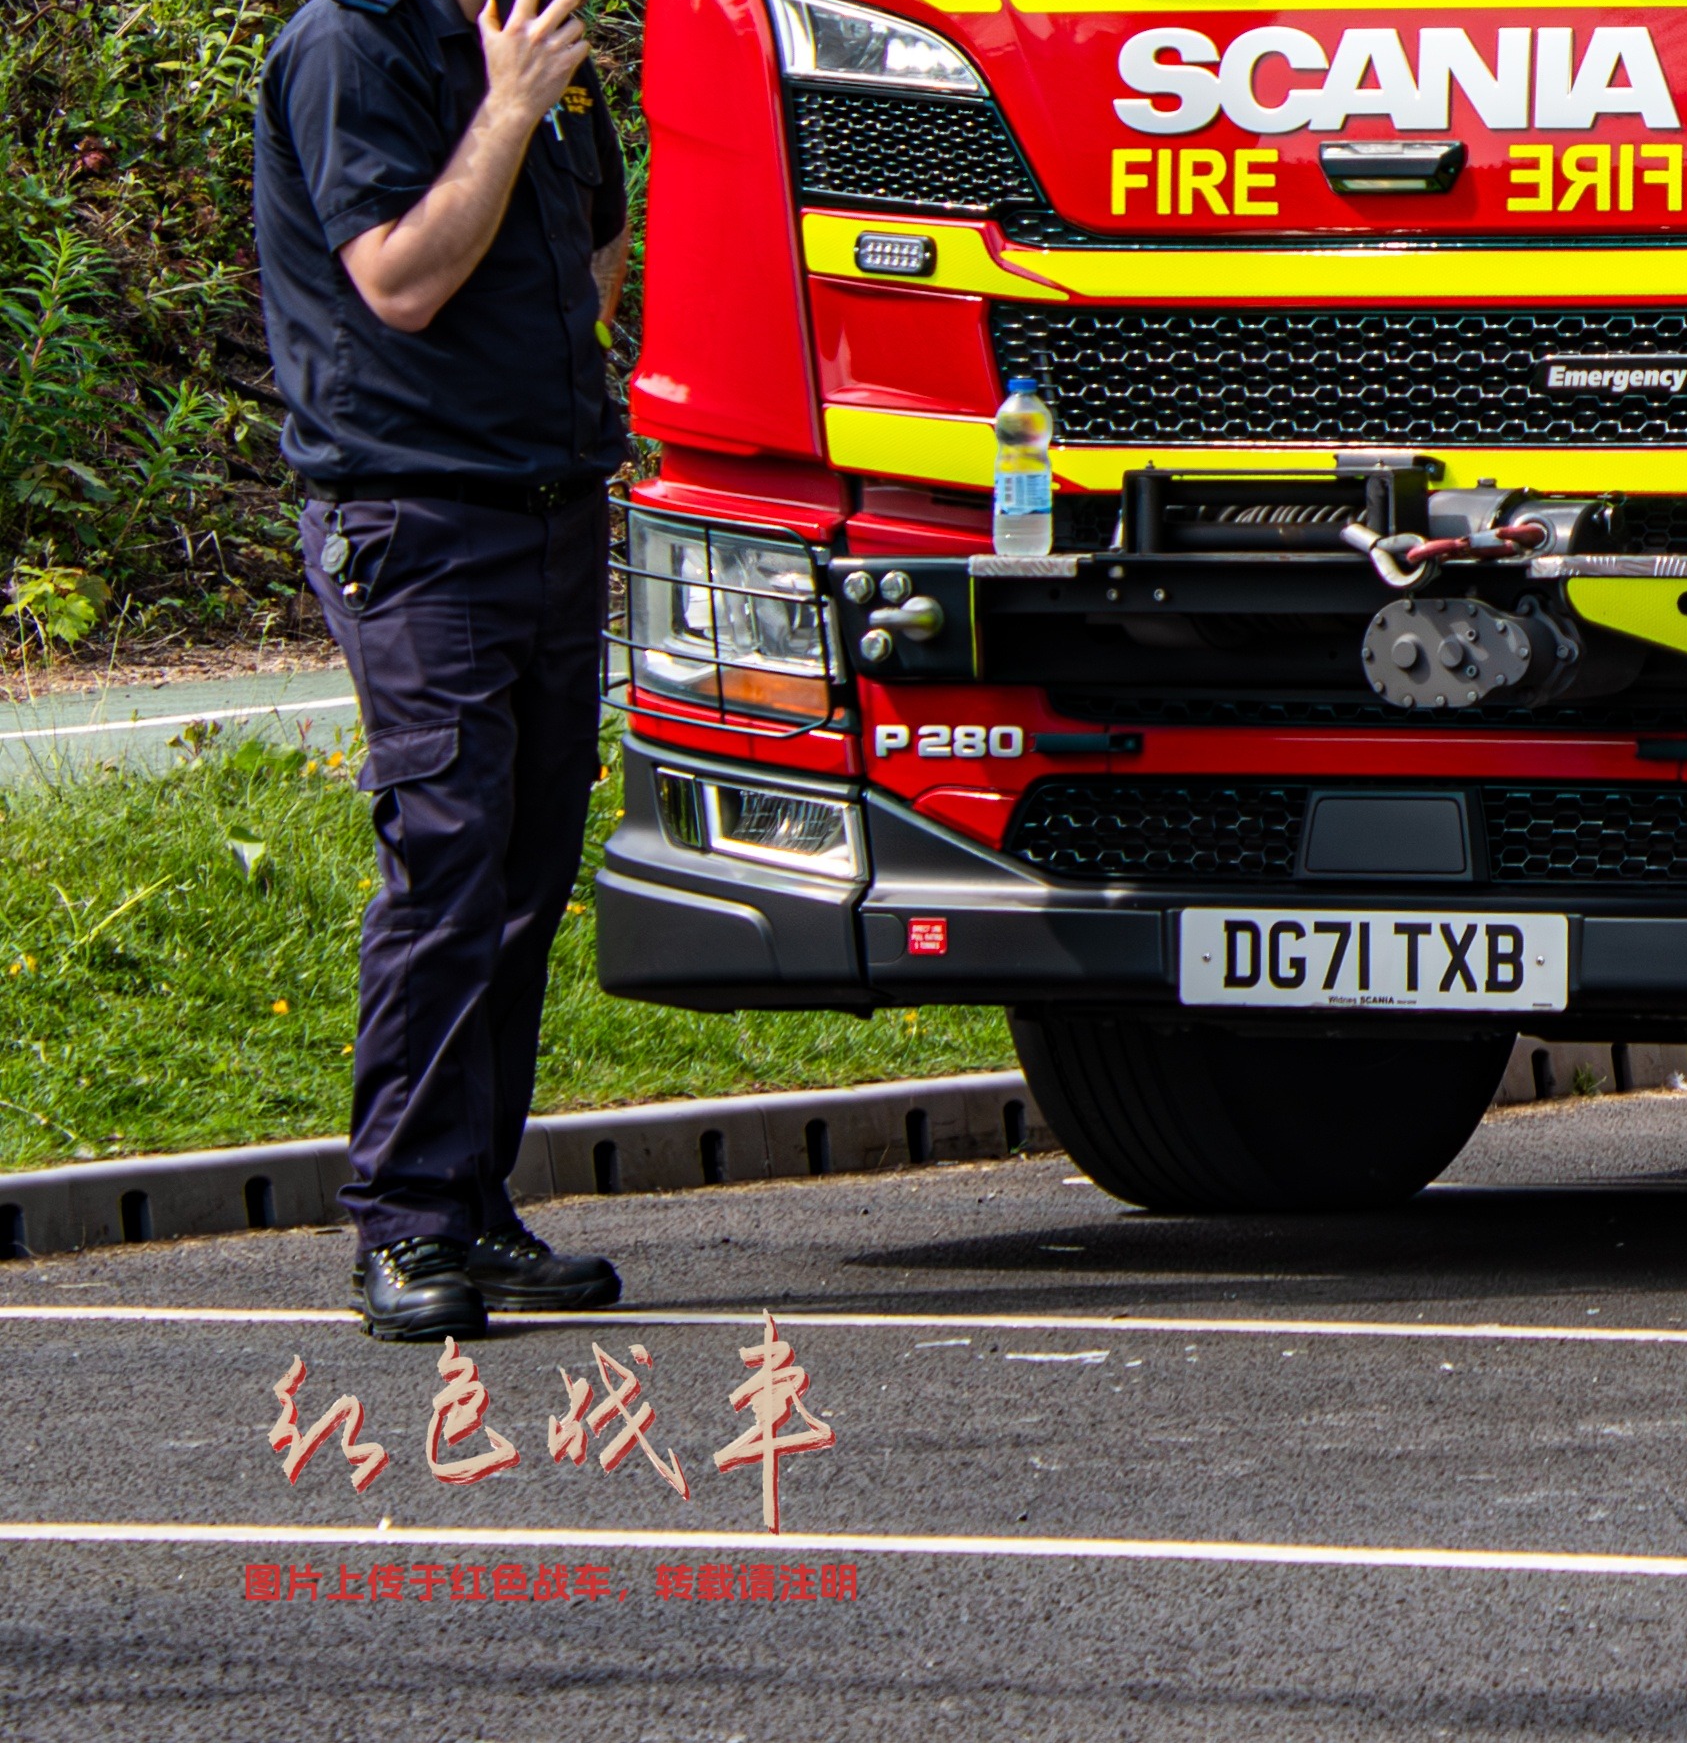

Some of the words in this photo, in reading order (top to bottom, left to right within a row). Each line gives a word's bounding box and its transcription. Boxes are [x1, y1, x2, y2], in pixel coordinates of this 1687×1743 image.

[1112, 26, 1682, 136] SCANIA
[1111, 148, 1280, 216] FIRE
[1546, 364, 1687, 396] Emergency
[874, 724, 911, 759] P
[916, 724, 1025, 759] 280
[1223, 919, 1371, 992] DG71
[1394, 921, 1526, 995] TXB
[1359, 995, 1395, 1005] SCANIA
